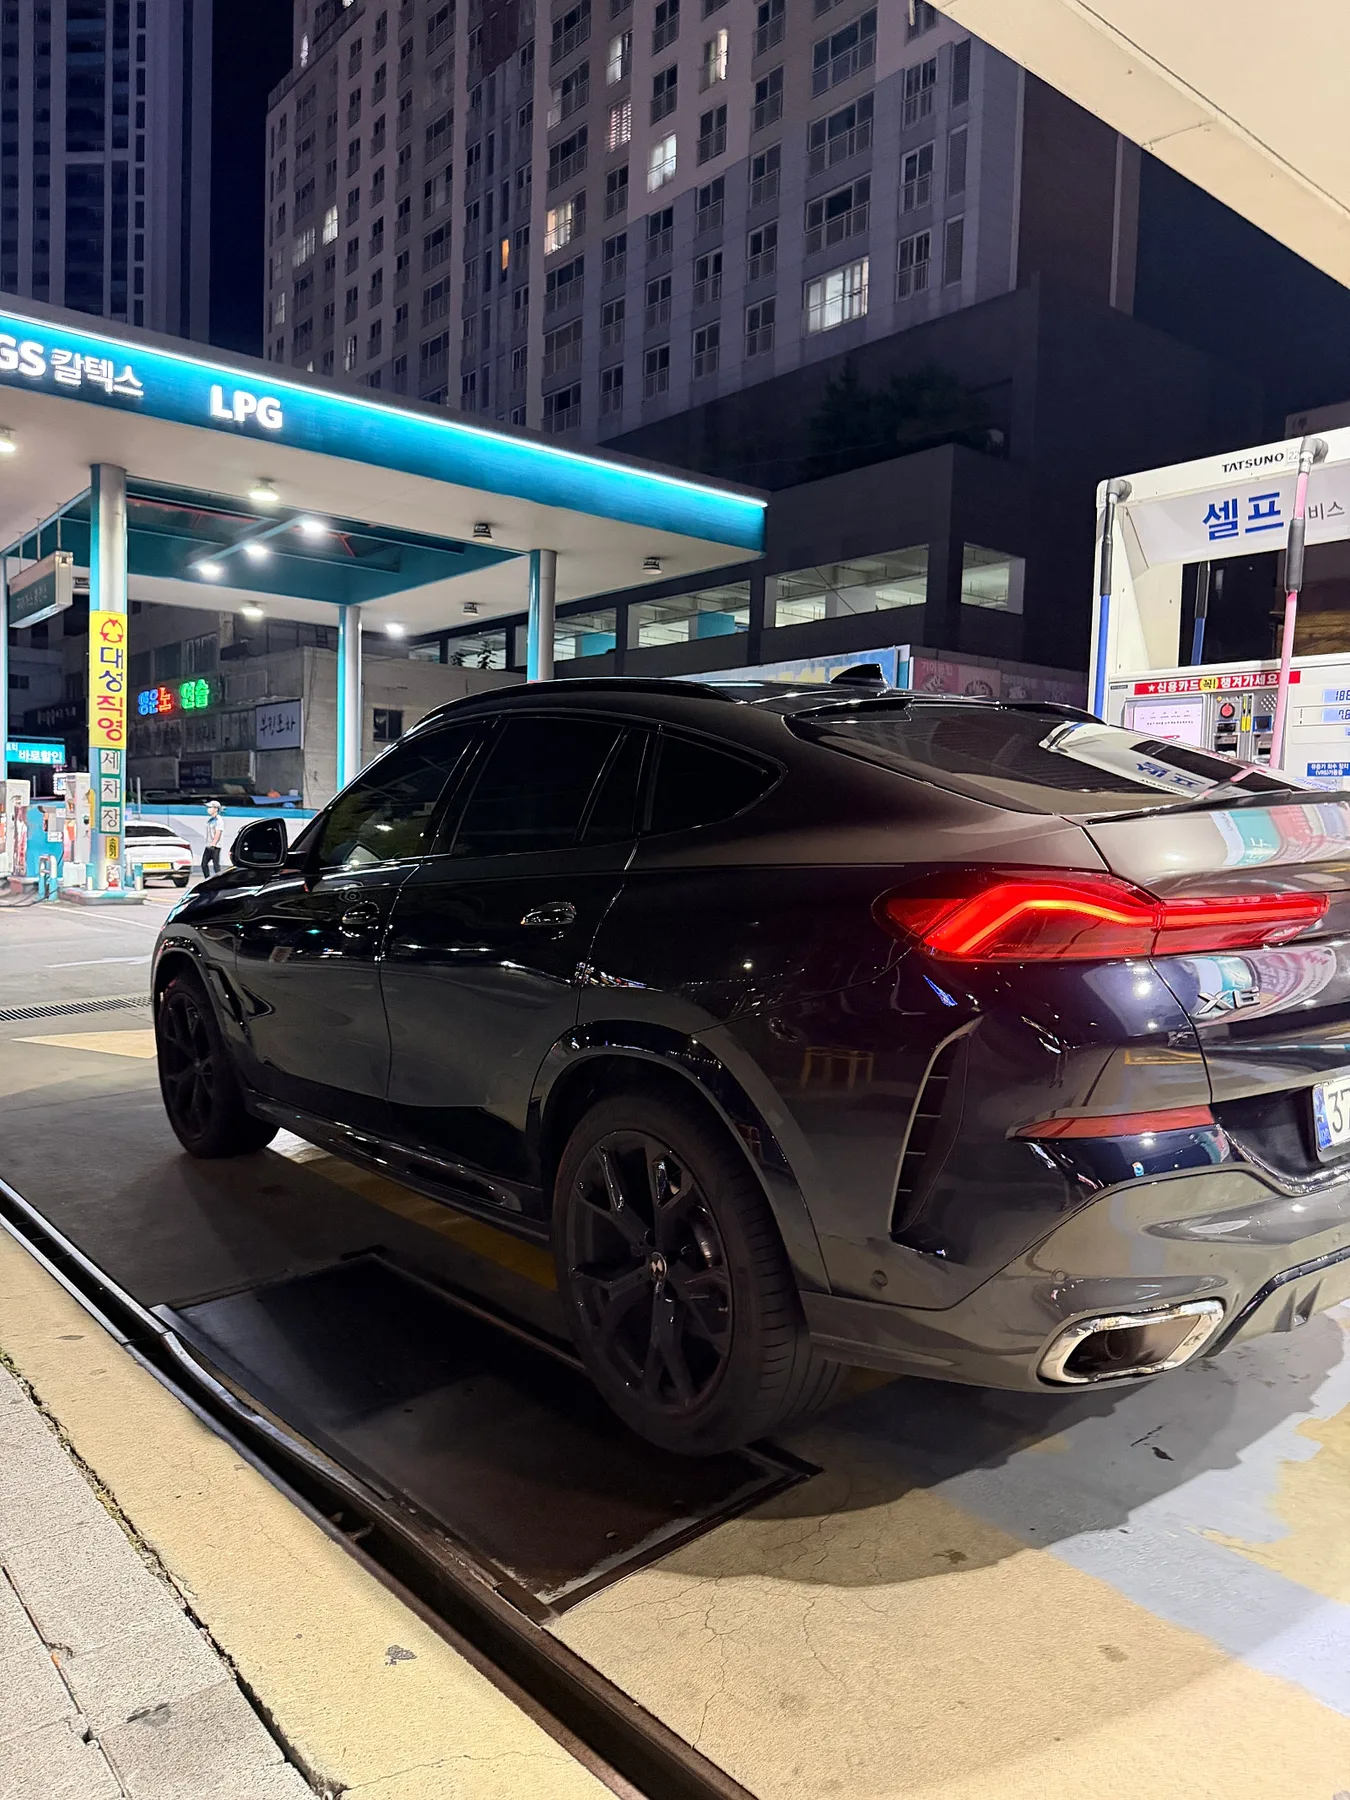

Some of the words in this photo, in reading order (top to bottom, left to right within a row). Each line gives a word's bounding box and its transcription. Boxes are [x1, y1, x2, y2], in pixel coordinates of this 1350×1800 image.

[0, 334, 46, 377] GS
[50, 348, 144, 397] 칼텍스
[210, 384, 283, 429] LPG
[1222, 452, 1284, 473] TATSUNO
[1202, 492, 1284, 542] 셀프
[1308, 501, 1345, 520] 비스
[1157, 679, 1200, 693] 신용카드
[102, 751, 121, 828] 세차장
[1197, 986, 1260, 1015] X6
